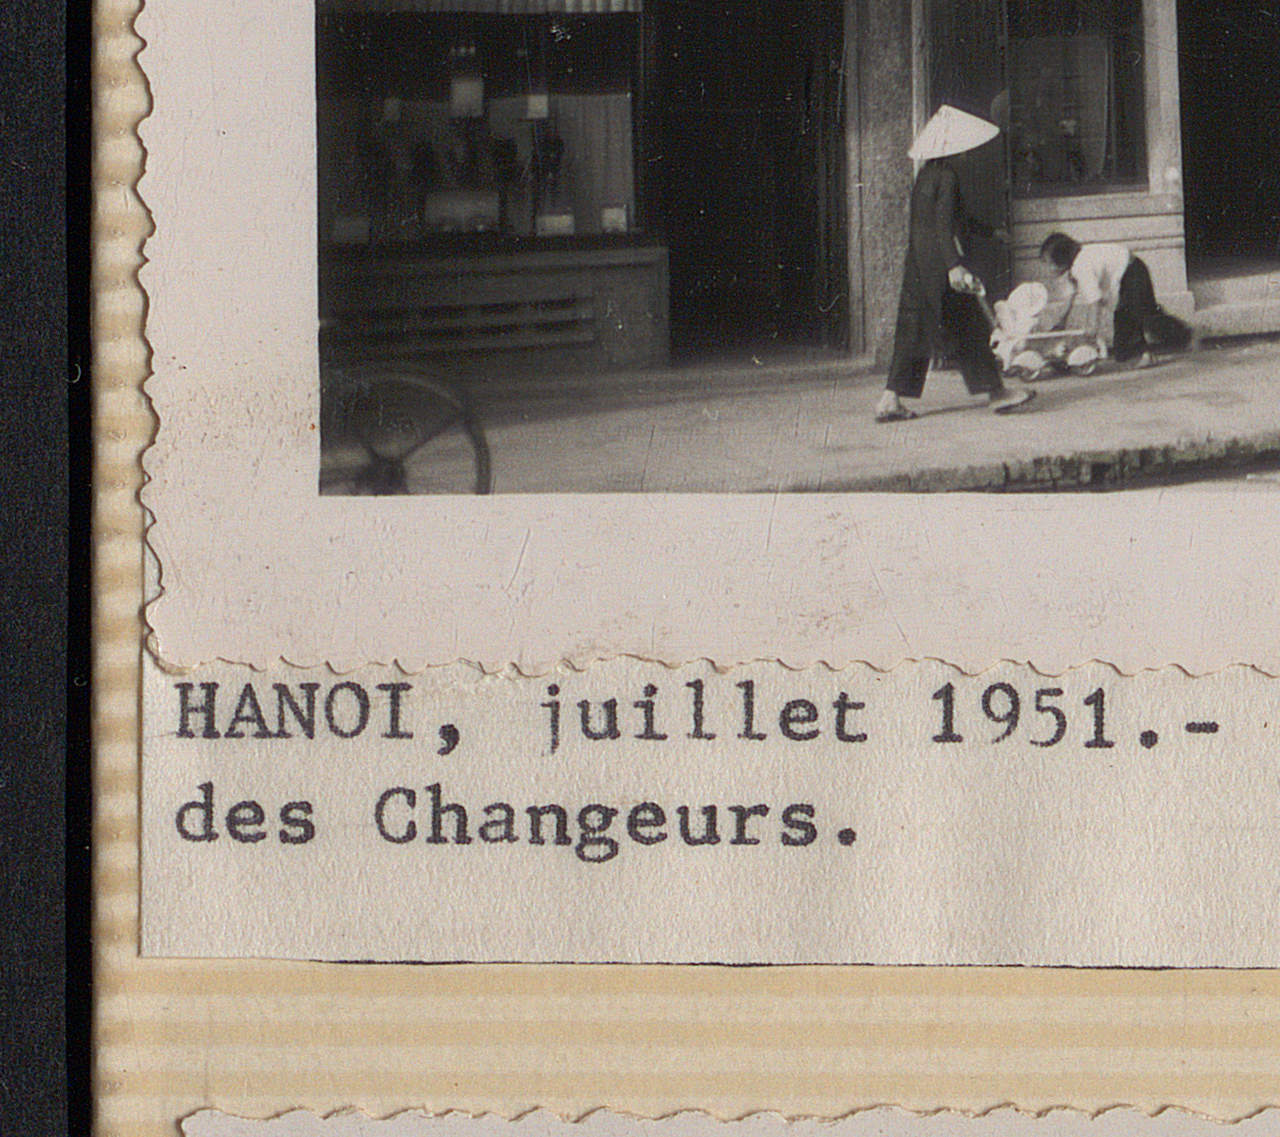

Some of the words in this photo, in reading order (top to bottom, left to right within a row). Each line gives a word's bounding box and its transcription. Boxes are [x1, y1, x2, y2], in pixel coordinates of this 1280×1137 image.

[175, 680, 462, 757] HANOI,
[538, 679, 869, 758] juillet
[174, 781, 317, 845] des
[373, 782, 858, 864] Changeurs.
